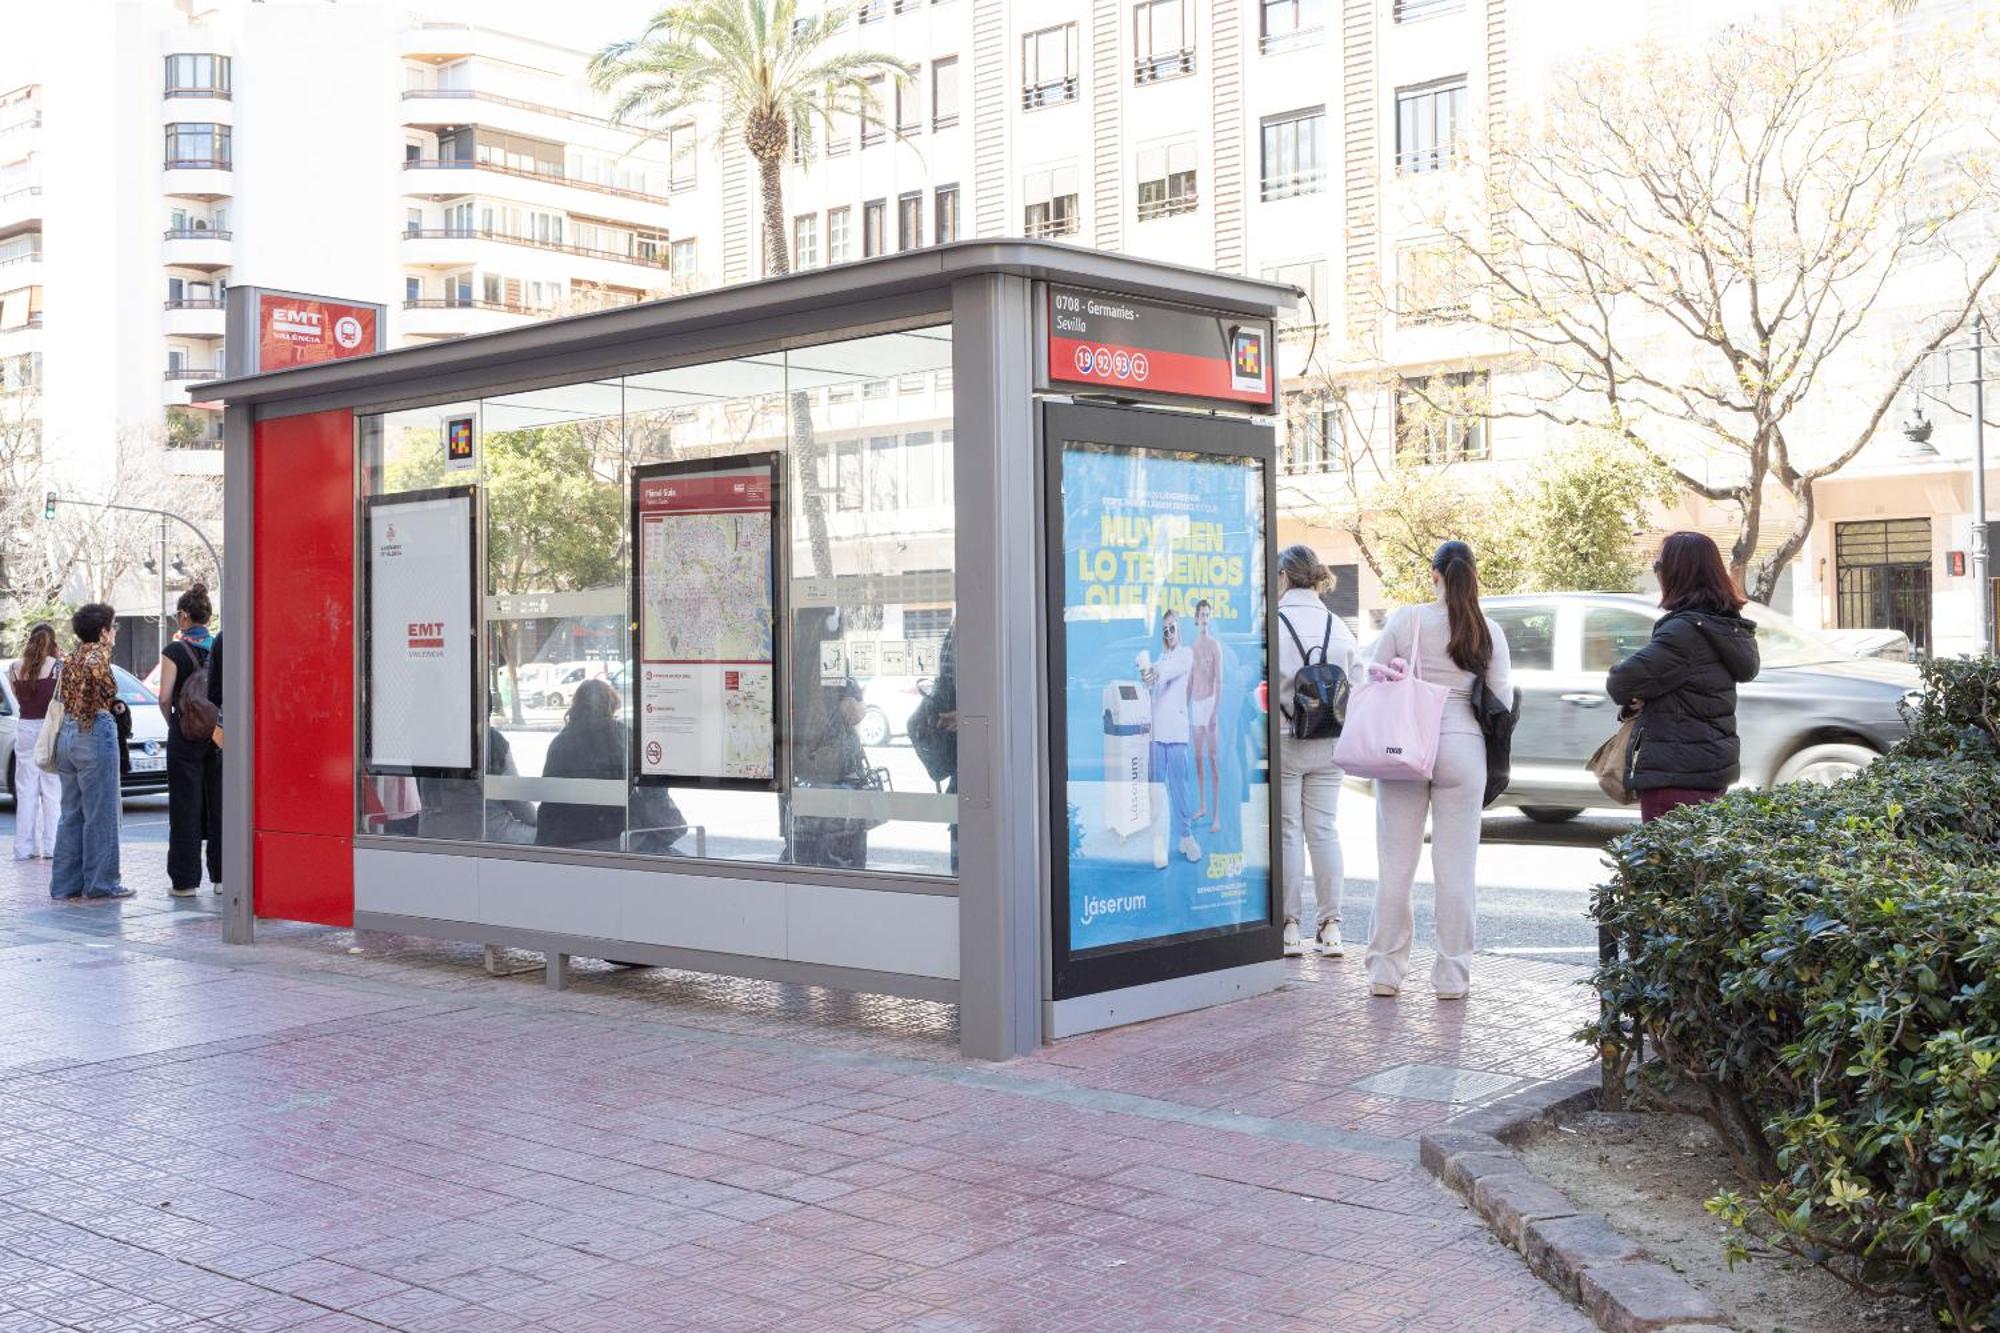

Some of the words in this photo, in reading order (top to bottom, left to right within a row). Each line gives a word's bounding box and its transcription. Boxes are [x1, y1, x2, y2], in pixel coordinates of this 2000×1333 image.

[273, 308, 321, 325] EMT
[1055, 295, 1080, 312] 0708
[1087, 300, 1134, 320] Germanies
[1056, 315, 1087, 333] Sevilla
[1078, 351, 1091, 367] 19
[1097, 354, 1109, 370] 92
[1115, 355, 1128, 372] 93
[1134, 359, 1145, 374] C2
[1101, 514, 1158, 548] MUY
[1079, 549, 1118, 582] LO
[1084, 583, 1143, 623] QUE
[408, 622, 444, 637] EMT
[1082, 895, 1147, 921] láserum
